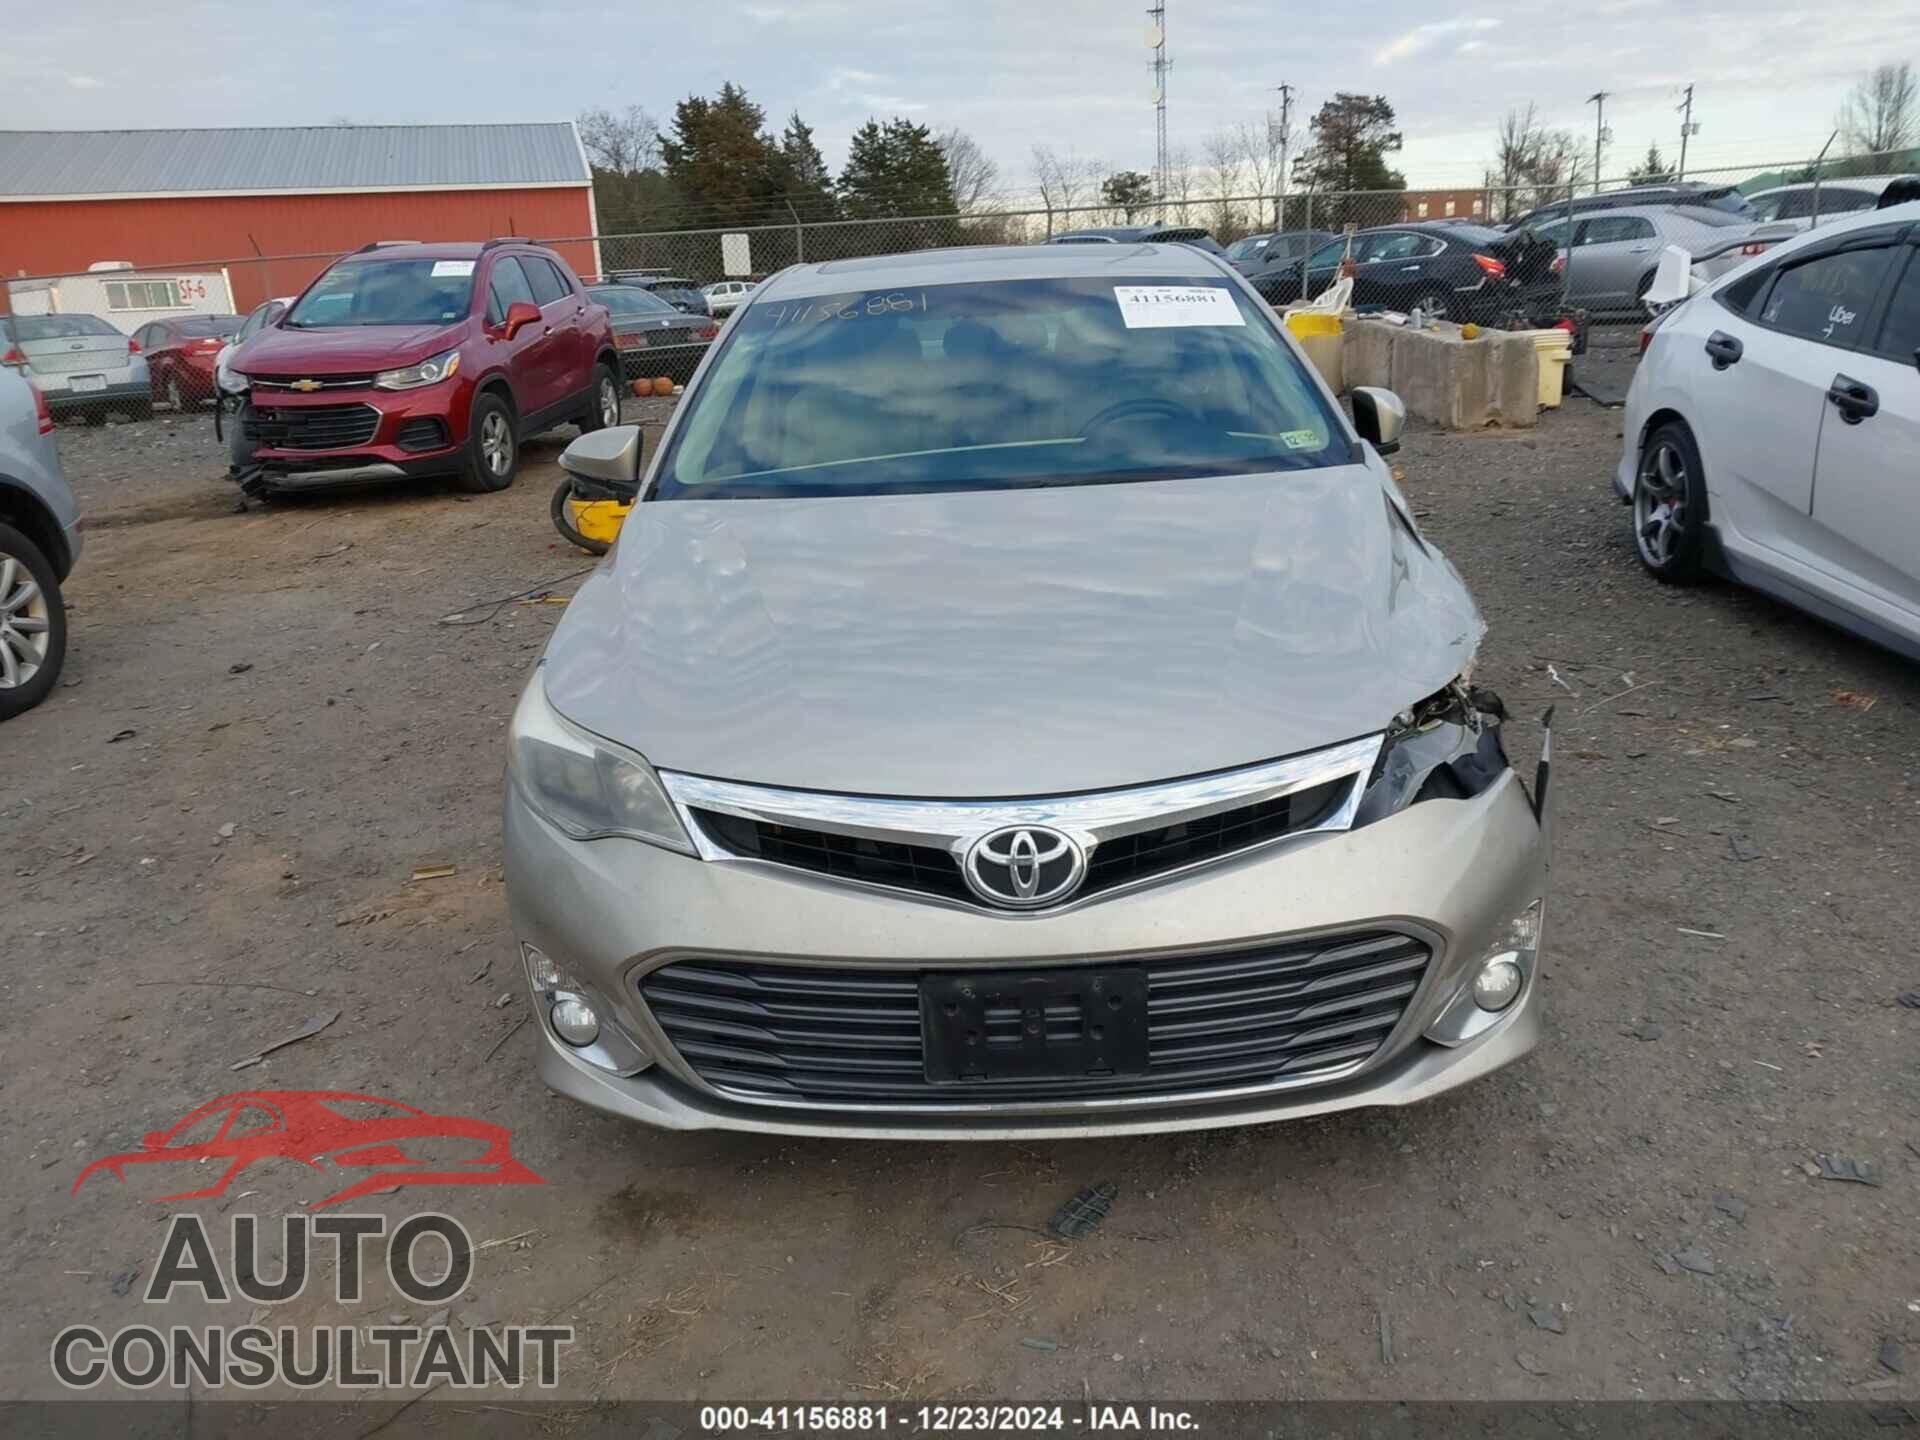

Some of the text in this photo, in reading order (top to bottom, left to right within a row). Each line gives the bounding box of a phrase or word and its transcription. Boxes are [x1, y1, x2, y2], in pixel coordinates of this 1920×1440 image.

[1130, 294, 1217, 303] 41156881
[766, 292, 927, 328] 41156881
[1828, 304, 1857, 325] Uber
